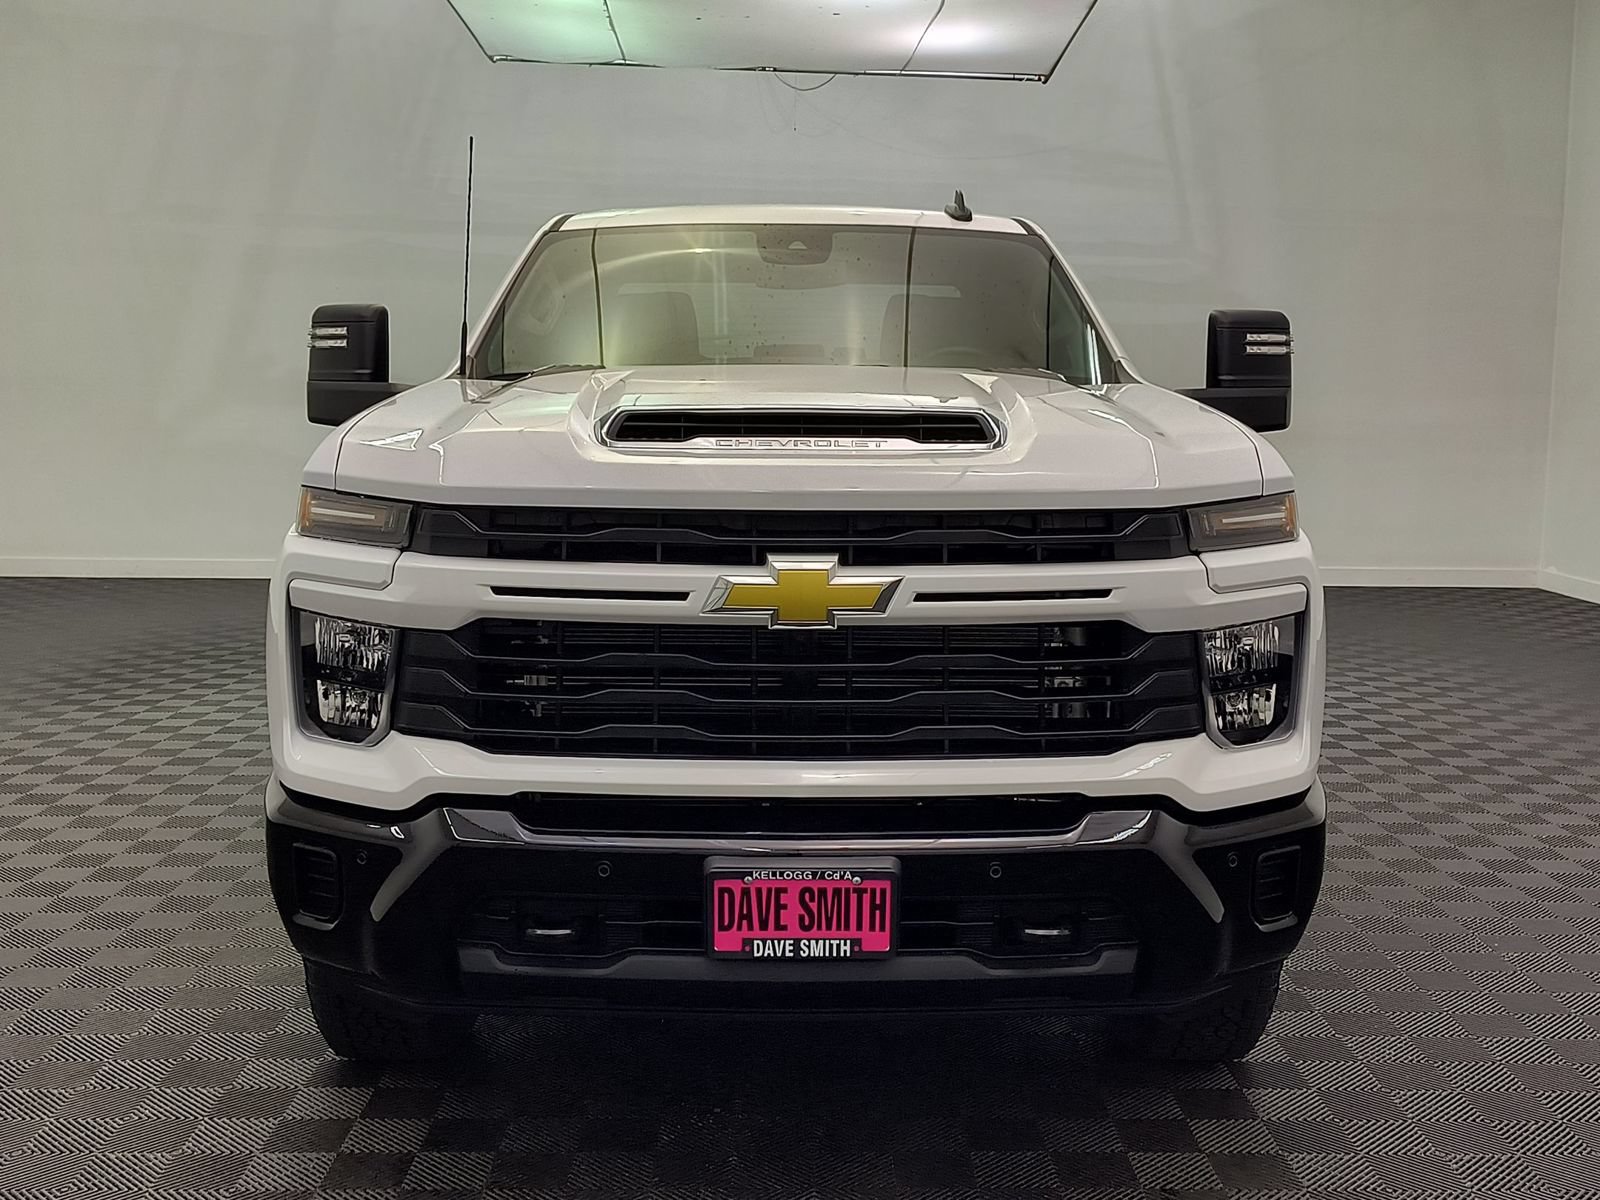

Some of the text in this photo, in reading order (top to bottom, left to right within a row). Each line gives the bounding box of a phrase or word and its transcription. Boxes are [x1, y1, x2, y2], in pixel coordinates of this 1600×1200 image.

[715, 439, 888, 448] CHEVROLET
[752, 870, 813, 880] KELLOGG
[824, 870, 853, 880] Cd'A
[717, 886, 887, 932] DAVE SMITH
[753, 939, 851, 957] DAVE SMITH
